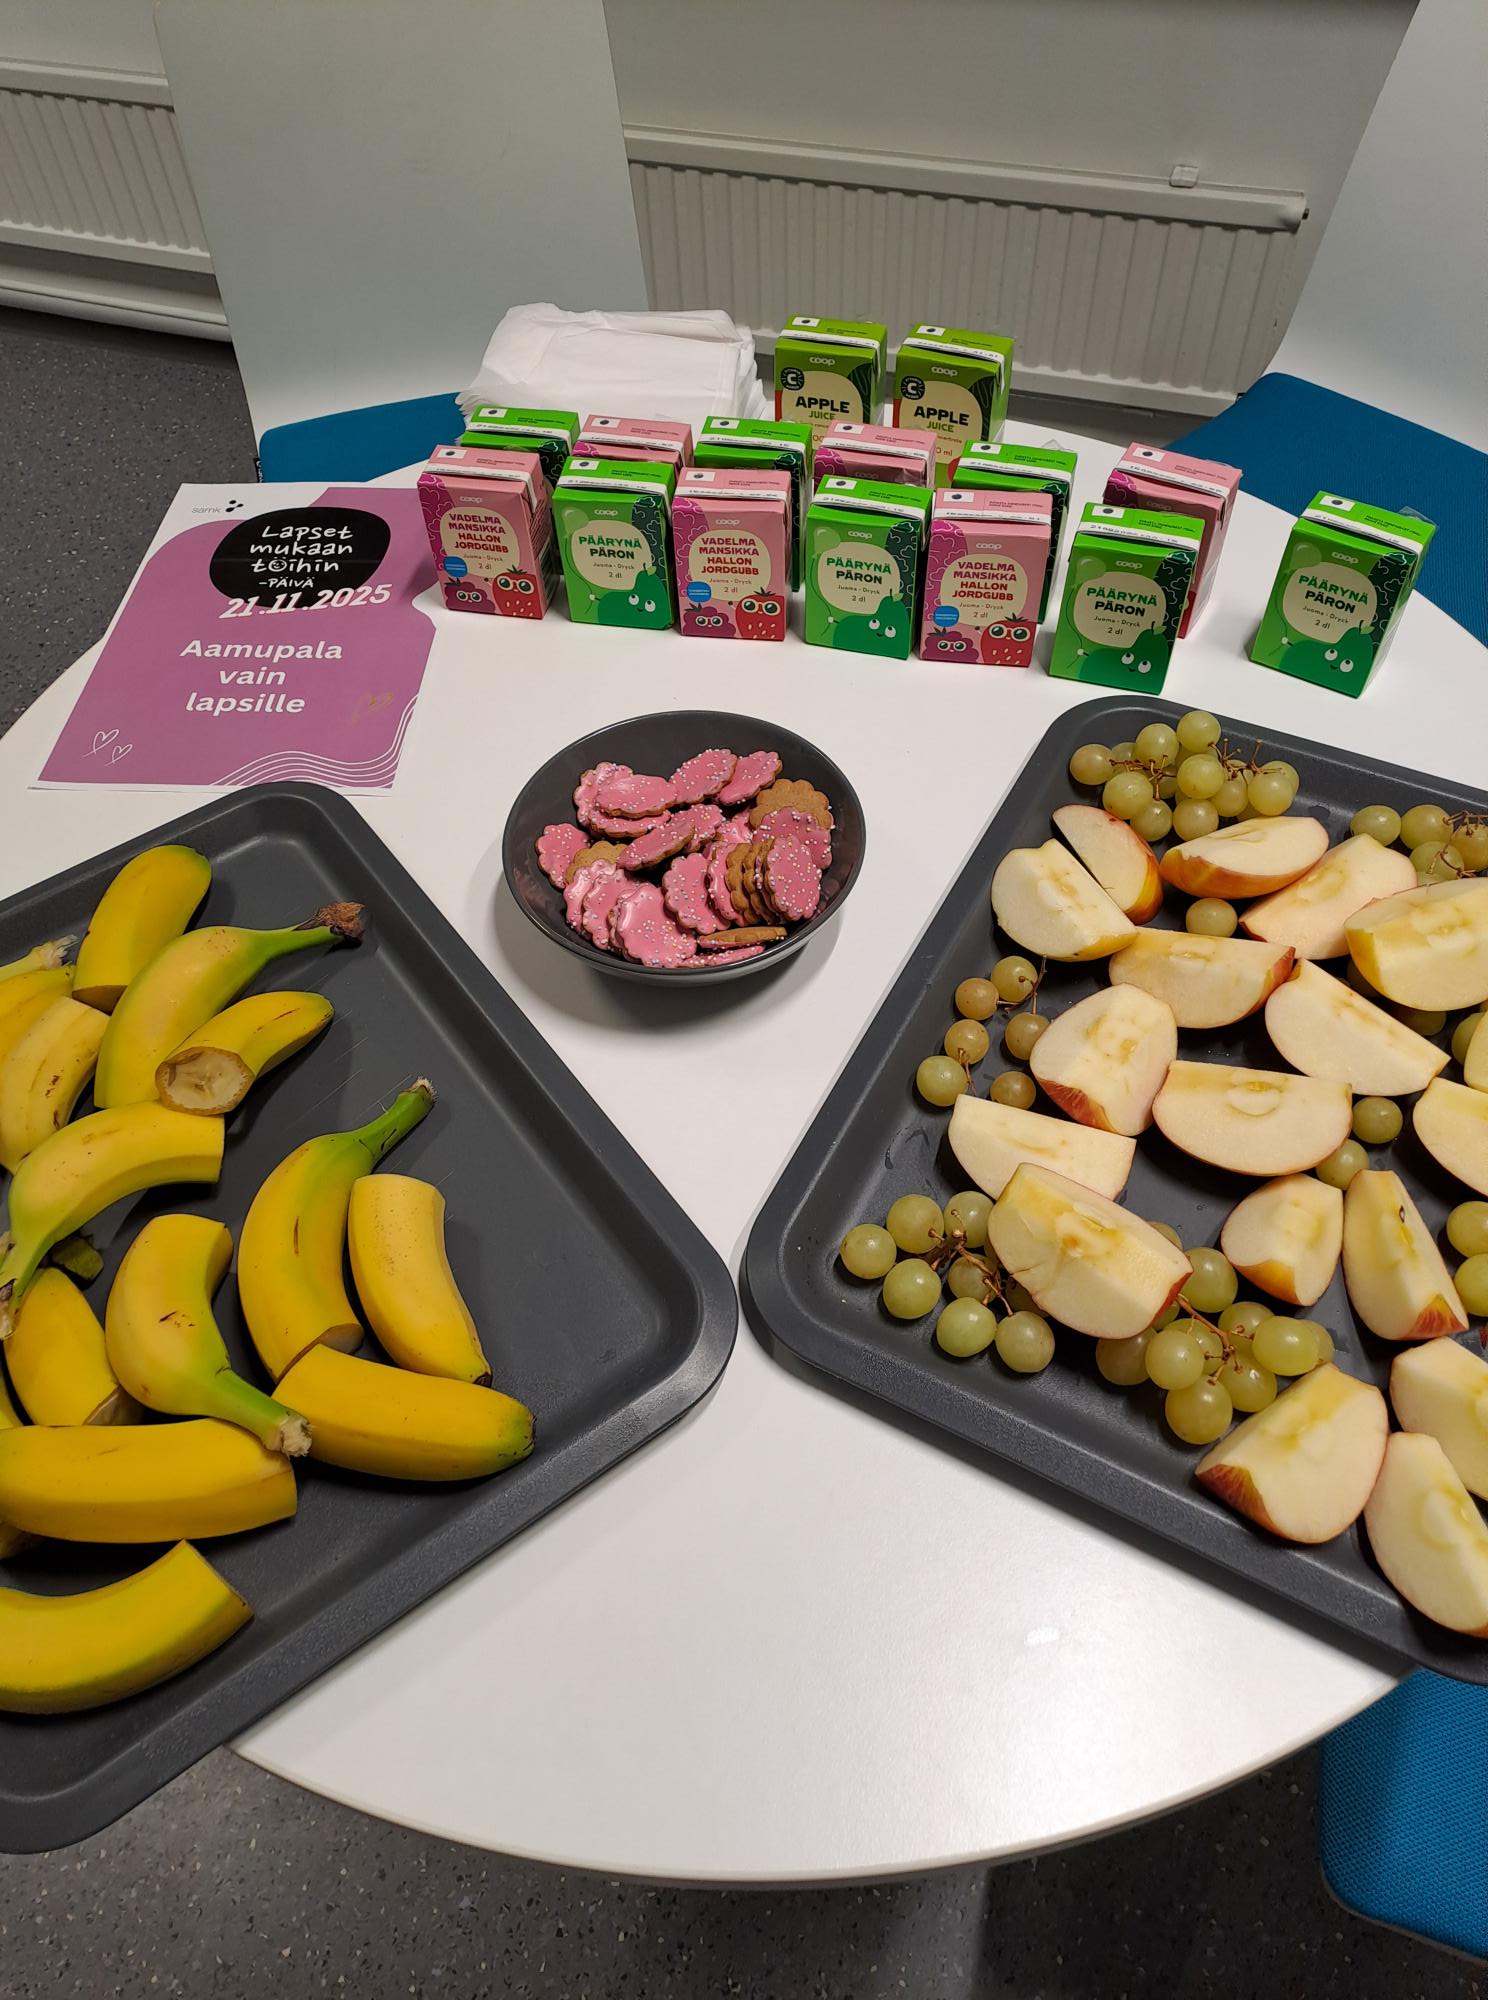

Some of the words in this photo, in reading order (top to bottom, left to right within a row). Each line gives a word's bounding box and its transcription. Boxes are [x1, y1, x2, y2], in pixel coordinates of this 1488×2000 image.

[809, 356, 836, 366] coop
[931, 366, 958, 377] coop
[787, 373, 798, 385] C
[907, 382, 917, 394] C
[795, 396, 850, 414] APPLE
[809, 411, 836, 420] JUICE
[914, 406, 969, 426] APPLE
[926, 421, 954, 433] JUICE
[191, 506, 221, 514] samk
[449, 513, 502, 525] VADELMA
[261, 525, 354, 542] Lapset
[448, 523, 506, 534] MANSIKKA
[458, 533, 501, 543] HALLON
[848, 530, 872, 540] coop
[454, 541, 509, 553] JORDGUBB
[578, 535, 642, 549] PÄÄRYNÄ
[701, 538, 756, 547] VADELMA
[250, 541, 353, 556] mukaan
[590, 548, 635, 559] PÄRON
[699, 547, 759, 556] MANSIKKA
[707, 557, 752, 565] HALLON
[1331, 551, 1359, 564] coop
[701, 566, 759, 575] JORDGUBB
[826, 557, 892, 574] PÄÄRYNÄ
[957, 562, 1015, 571] VADELMA
[1115, 560, 1143, 570] coop
[836, 570, 883, 584] PÄRON
[953, 571, 1017, 581] MANSIKKA
[960, 581, 1008, 591] HALLON
[1298, 575, 1369, 606] PÄÄRYNÄ
[218, 584, 393, 619] 21.11.2025
[952, 590, 1014, 601] JORDGUBB
[1086, 587, 1157, 606] PÄÄRYNÄ
[1304, 590, 1356, 614] PÄRON
[1094, 600, 1145, 617] PÄRON
[179, 640, 343, 663] Aamupala
[219, 666, 286, 685] vain
[185, 692, 305, 717] lapsille
